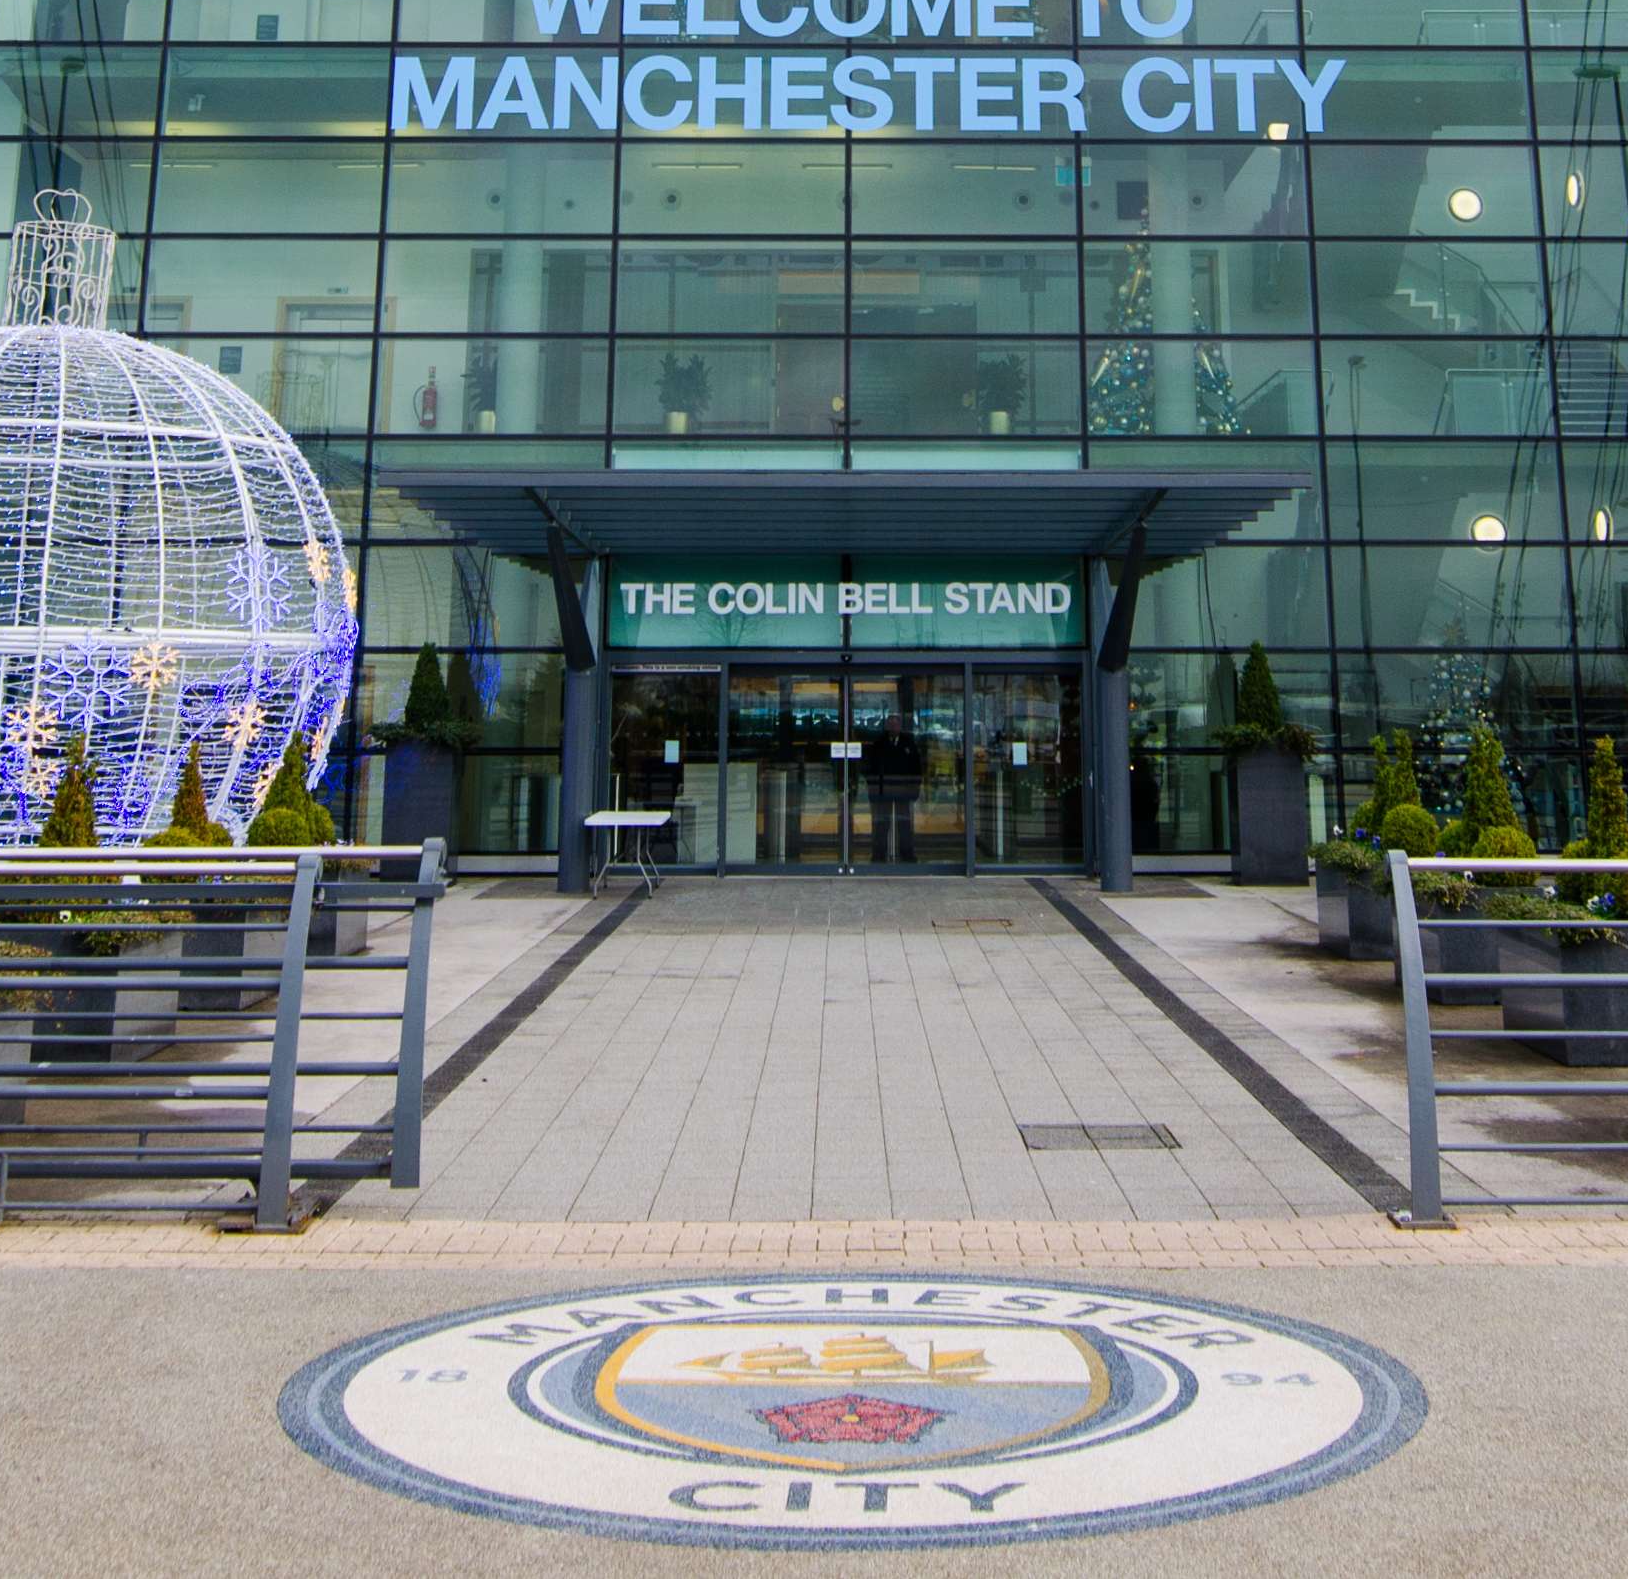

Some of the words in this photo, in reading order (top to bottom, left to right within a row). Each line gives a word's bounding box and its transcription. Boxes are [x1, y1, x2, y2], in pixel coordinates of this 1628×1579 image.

[390, 55, 1087, 132] MANCHESTER
[1121, 57, 1347, 133] CITY
[620, 582, 696, 615] THE
[707, 582, 825, 615] COLIN
[838, 582, 933, 615] BELL
[943, 582, 1072, 615] STAND
[467, 1288, 1256, 1349] MANCHESTER
[397, 1367, 470, 1384] 18
[1220, 1371, 1318, 1388] 94
[668, 1479, 1027, 1512] CITY
